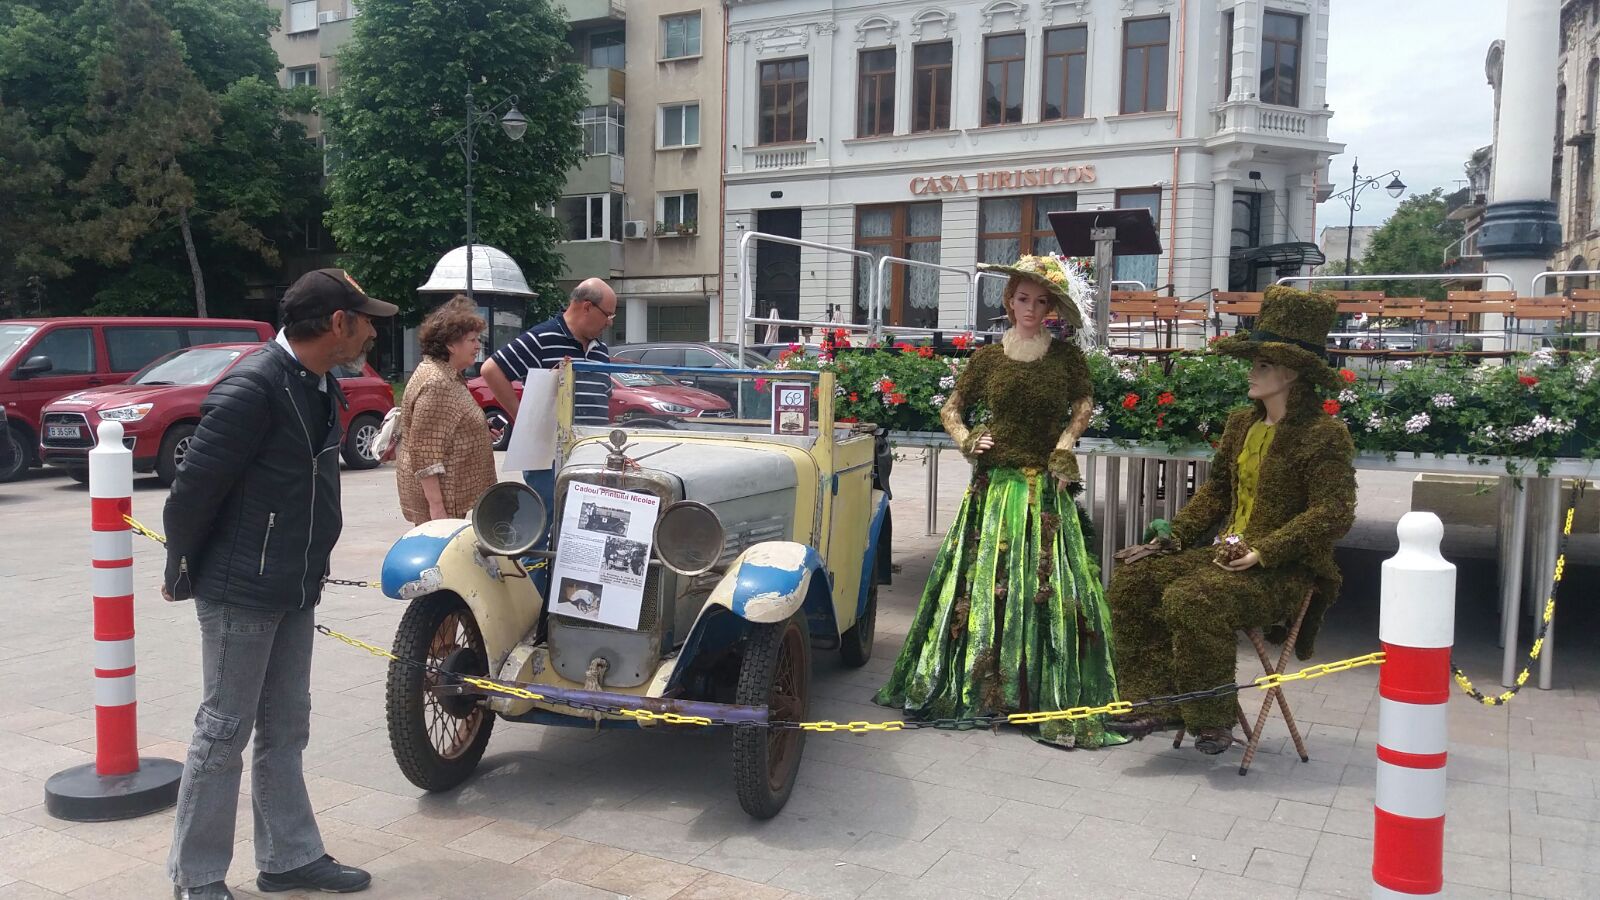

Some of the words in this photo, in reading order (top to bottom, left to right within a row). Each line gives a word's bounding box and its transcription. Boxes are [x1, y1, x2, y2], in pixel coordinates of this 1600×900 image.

[909, 174, 969, 195] CASA
[976, 165, 1096, 192] HRISICOS
[785, 391, 802, 405] 68
[574, 484, 599, 494] Cadoul
[630, 495, 656, 505] Nicolae
